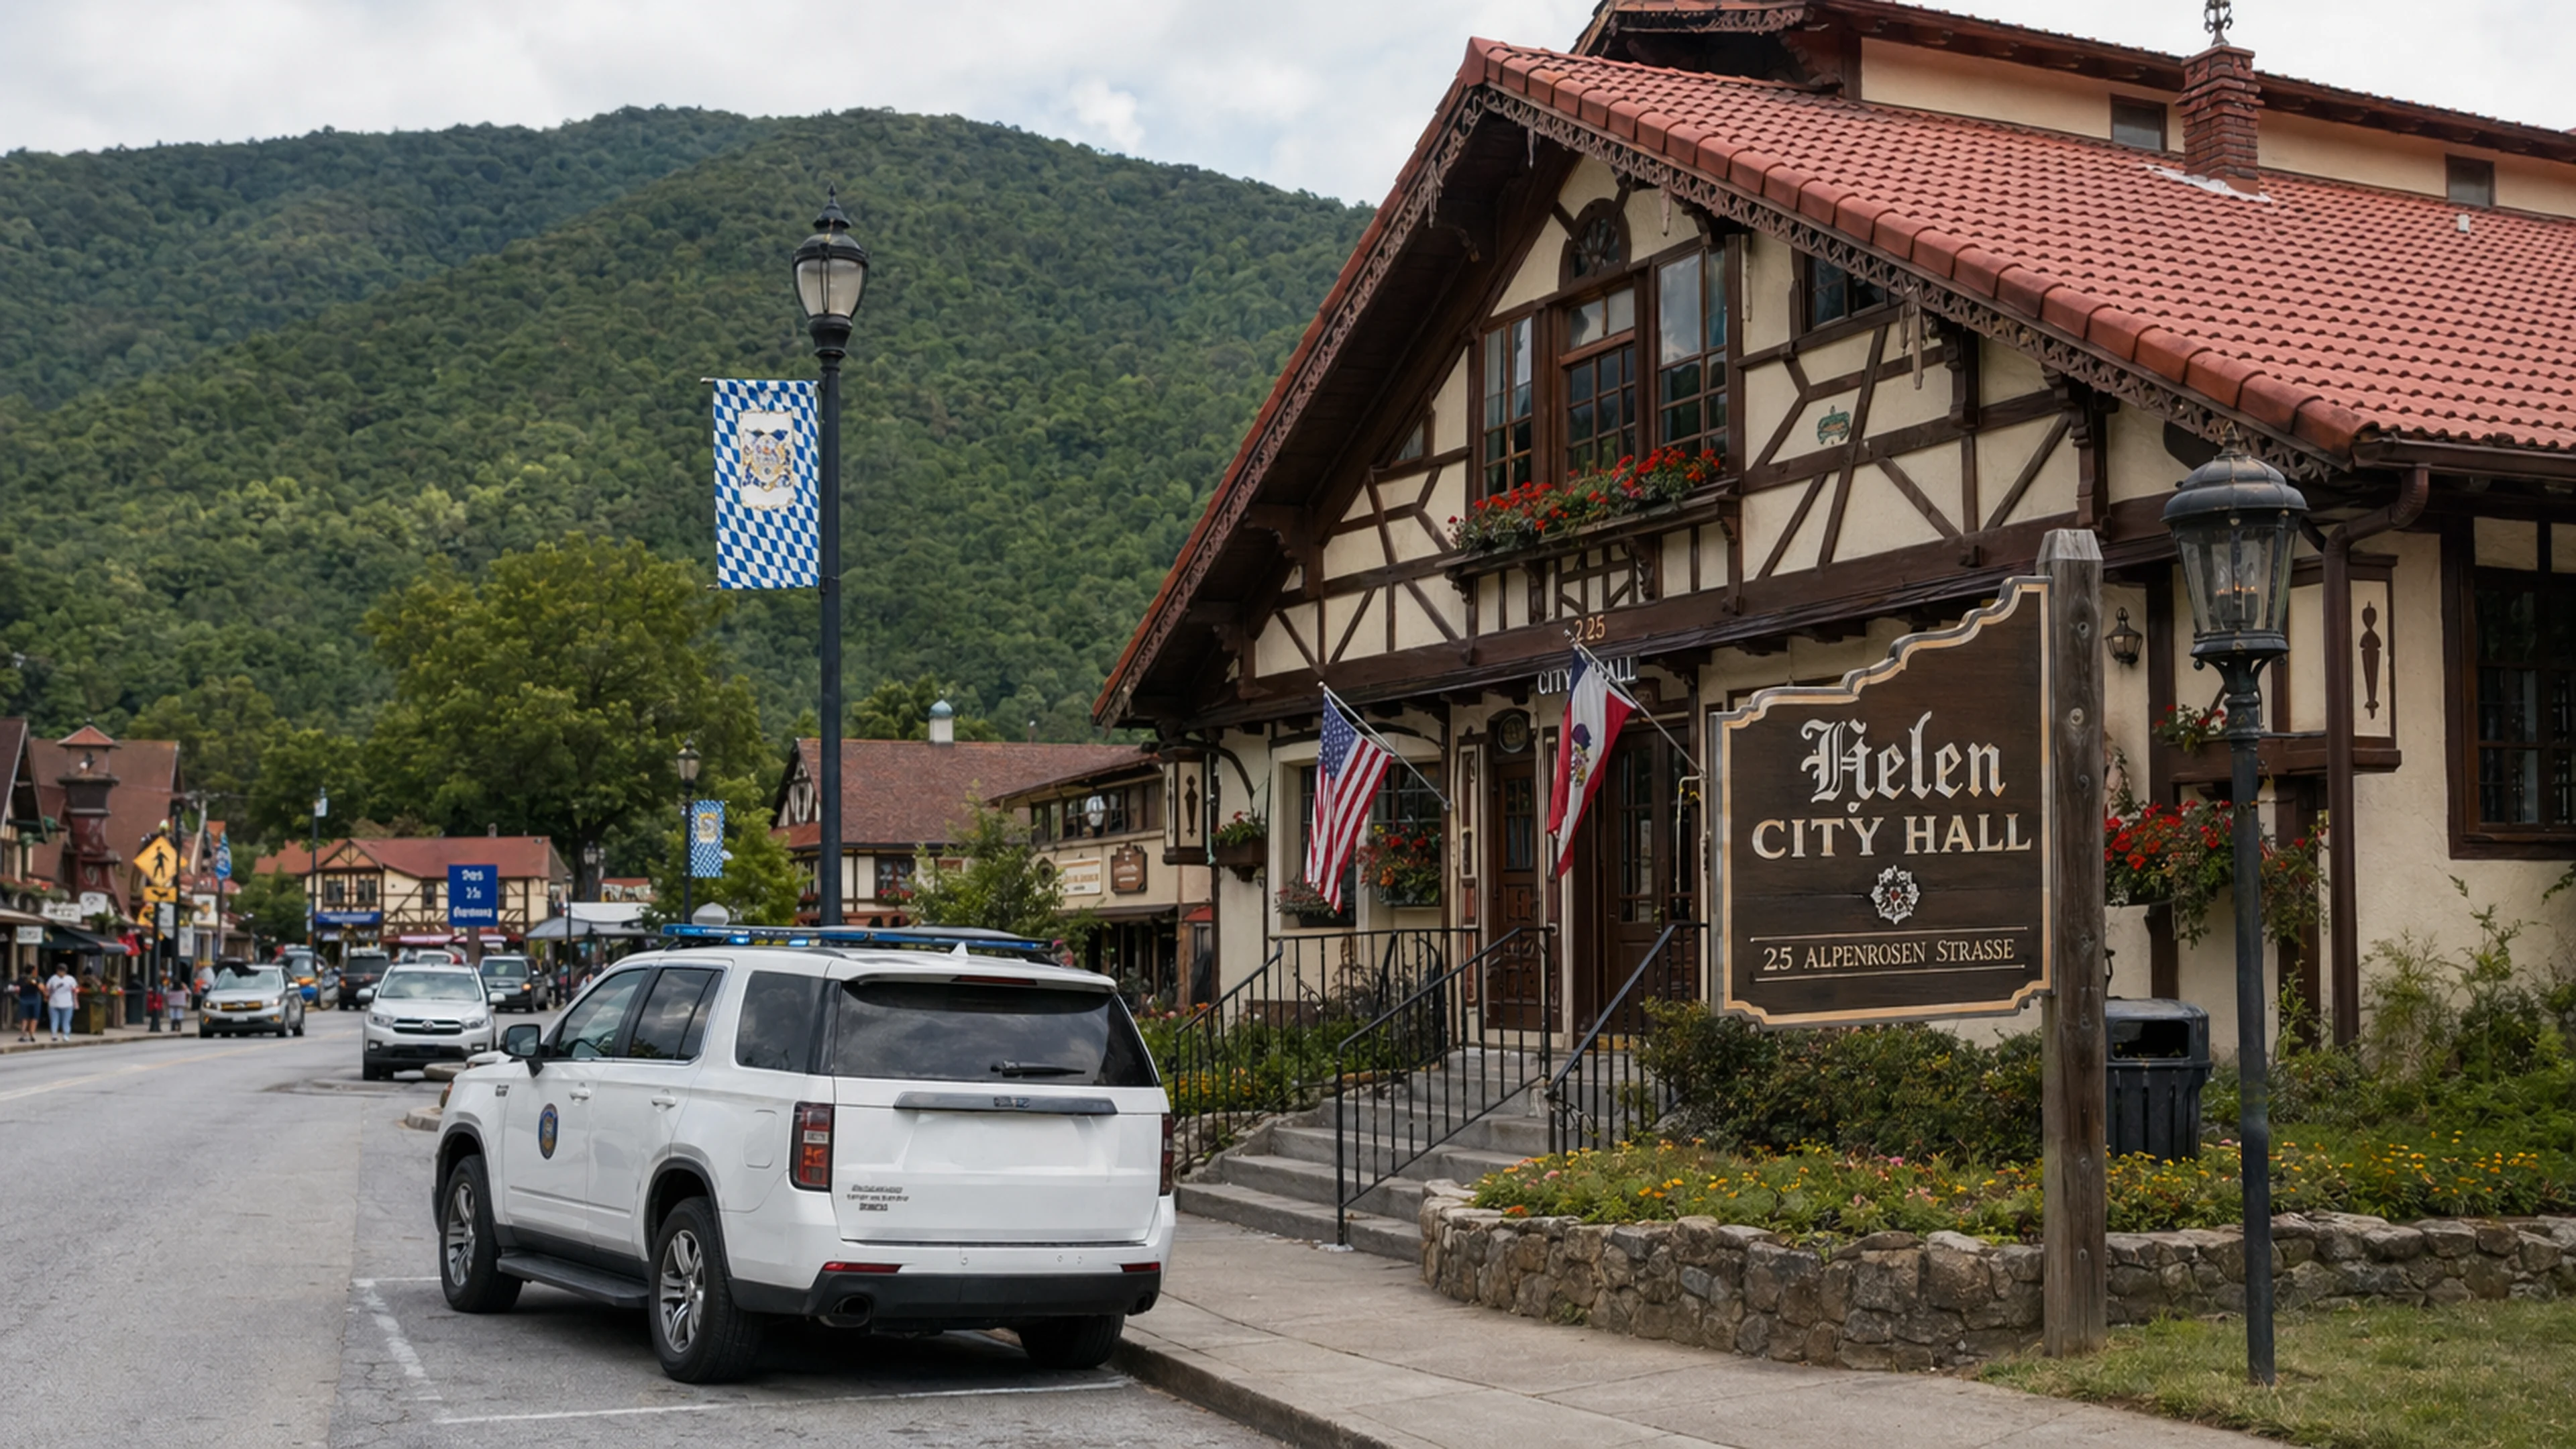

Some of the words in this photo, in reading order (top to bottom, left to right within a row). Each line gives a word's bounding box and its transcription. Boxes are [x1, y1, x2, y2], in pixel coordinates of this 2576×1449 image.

[1592, 656, 1636, 682] ALL
[1800, 710, 2006, 803] Helen
[1751, 816, 1884, 859] CITY
[1903, 813, 2032, 855] HALL
[1762, 946, 1793, 971] 25
[1803, 941, 1927, 969] ALPENROSEN
[1936, 938, 2015, 963] STRASSE
